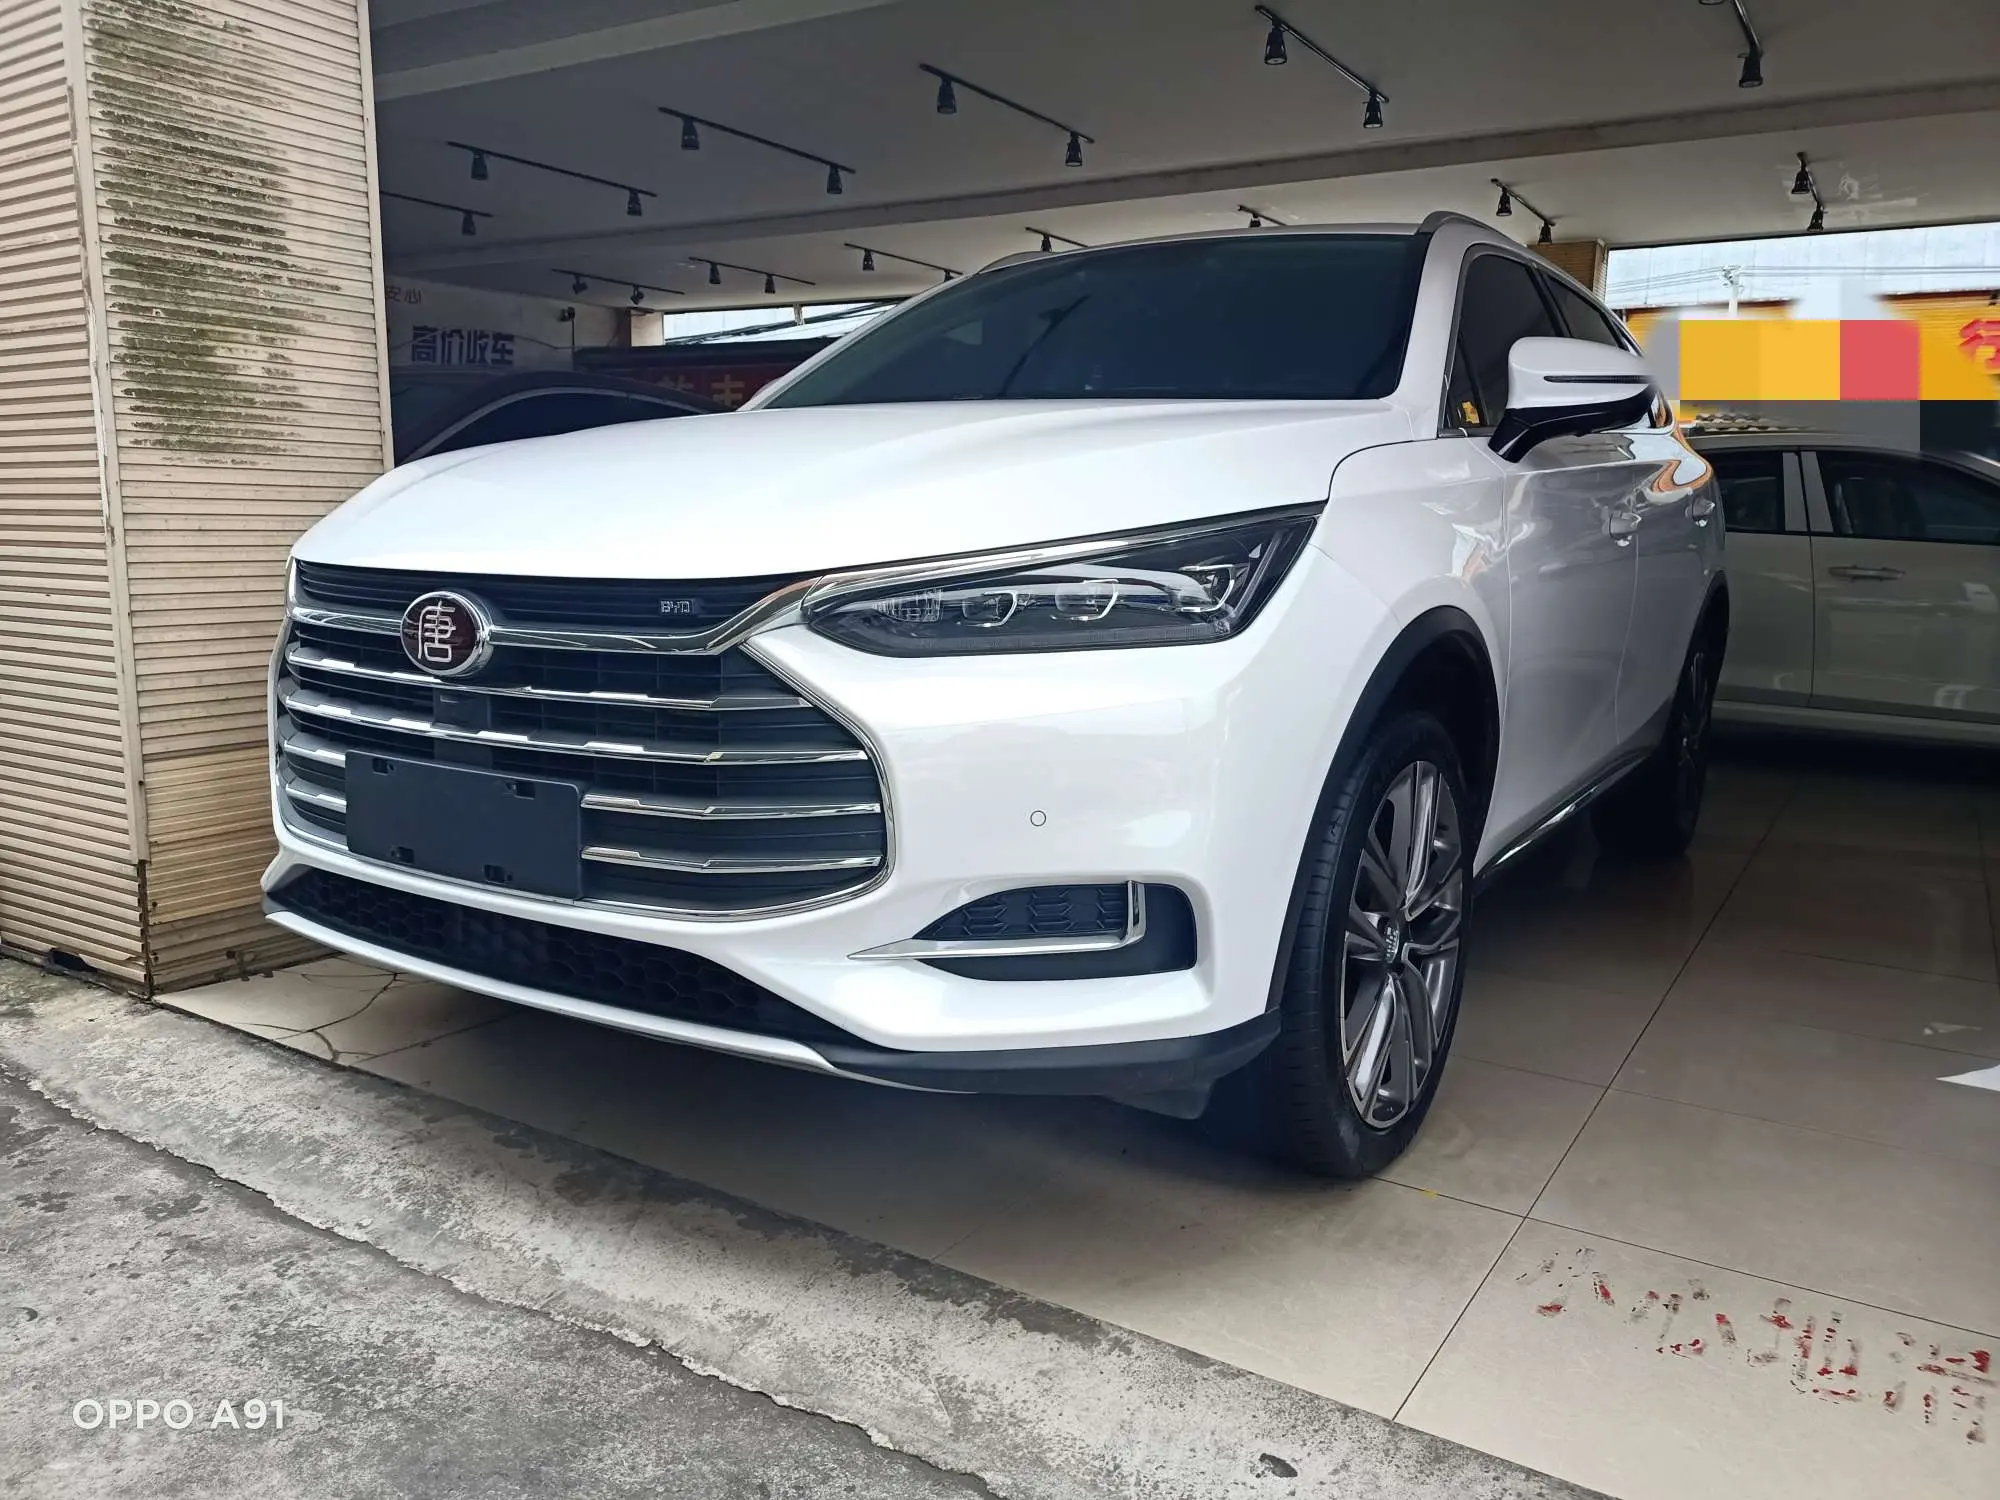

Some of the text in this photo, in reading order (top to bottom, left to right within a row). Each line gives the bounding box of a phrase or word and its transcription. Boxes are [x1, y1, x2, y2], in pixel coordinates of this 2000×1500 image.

[412, 325, 515, 365] 高价收车
[660, 600, 690, 614] BYD
[417, 600, 457, 662] 唐
